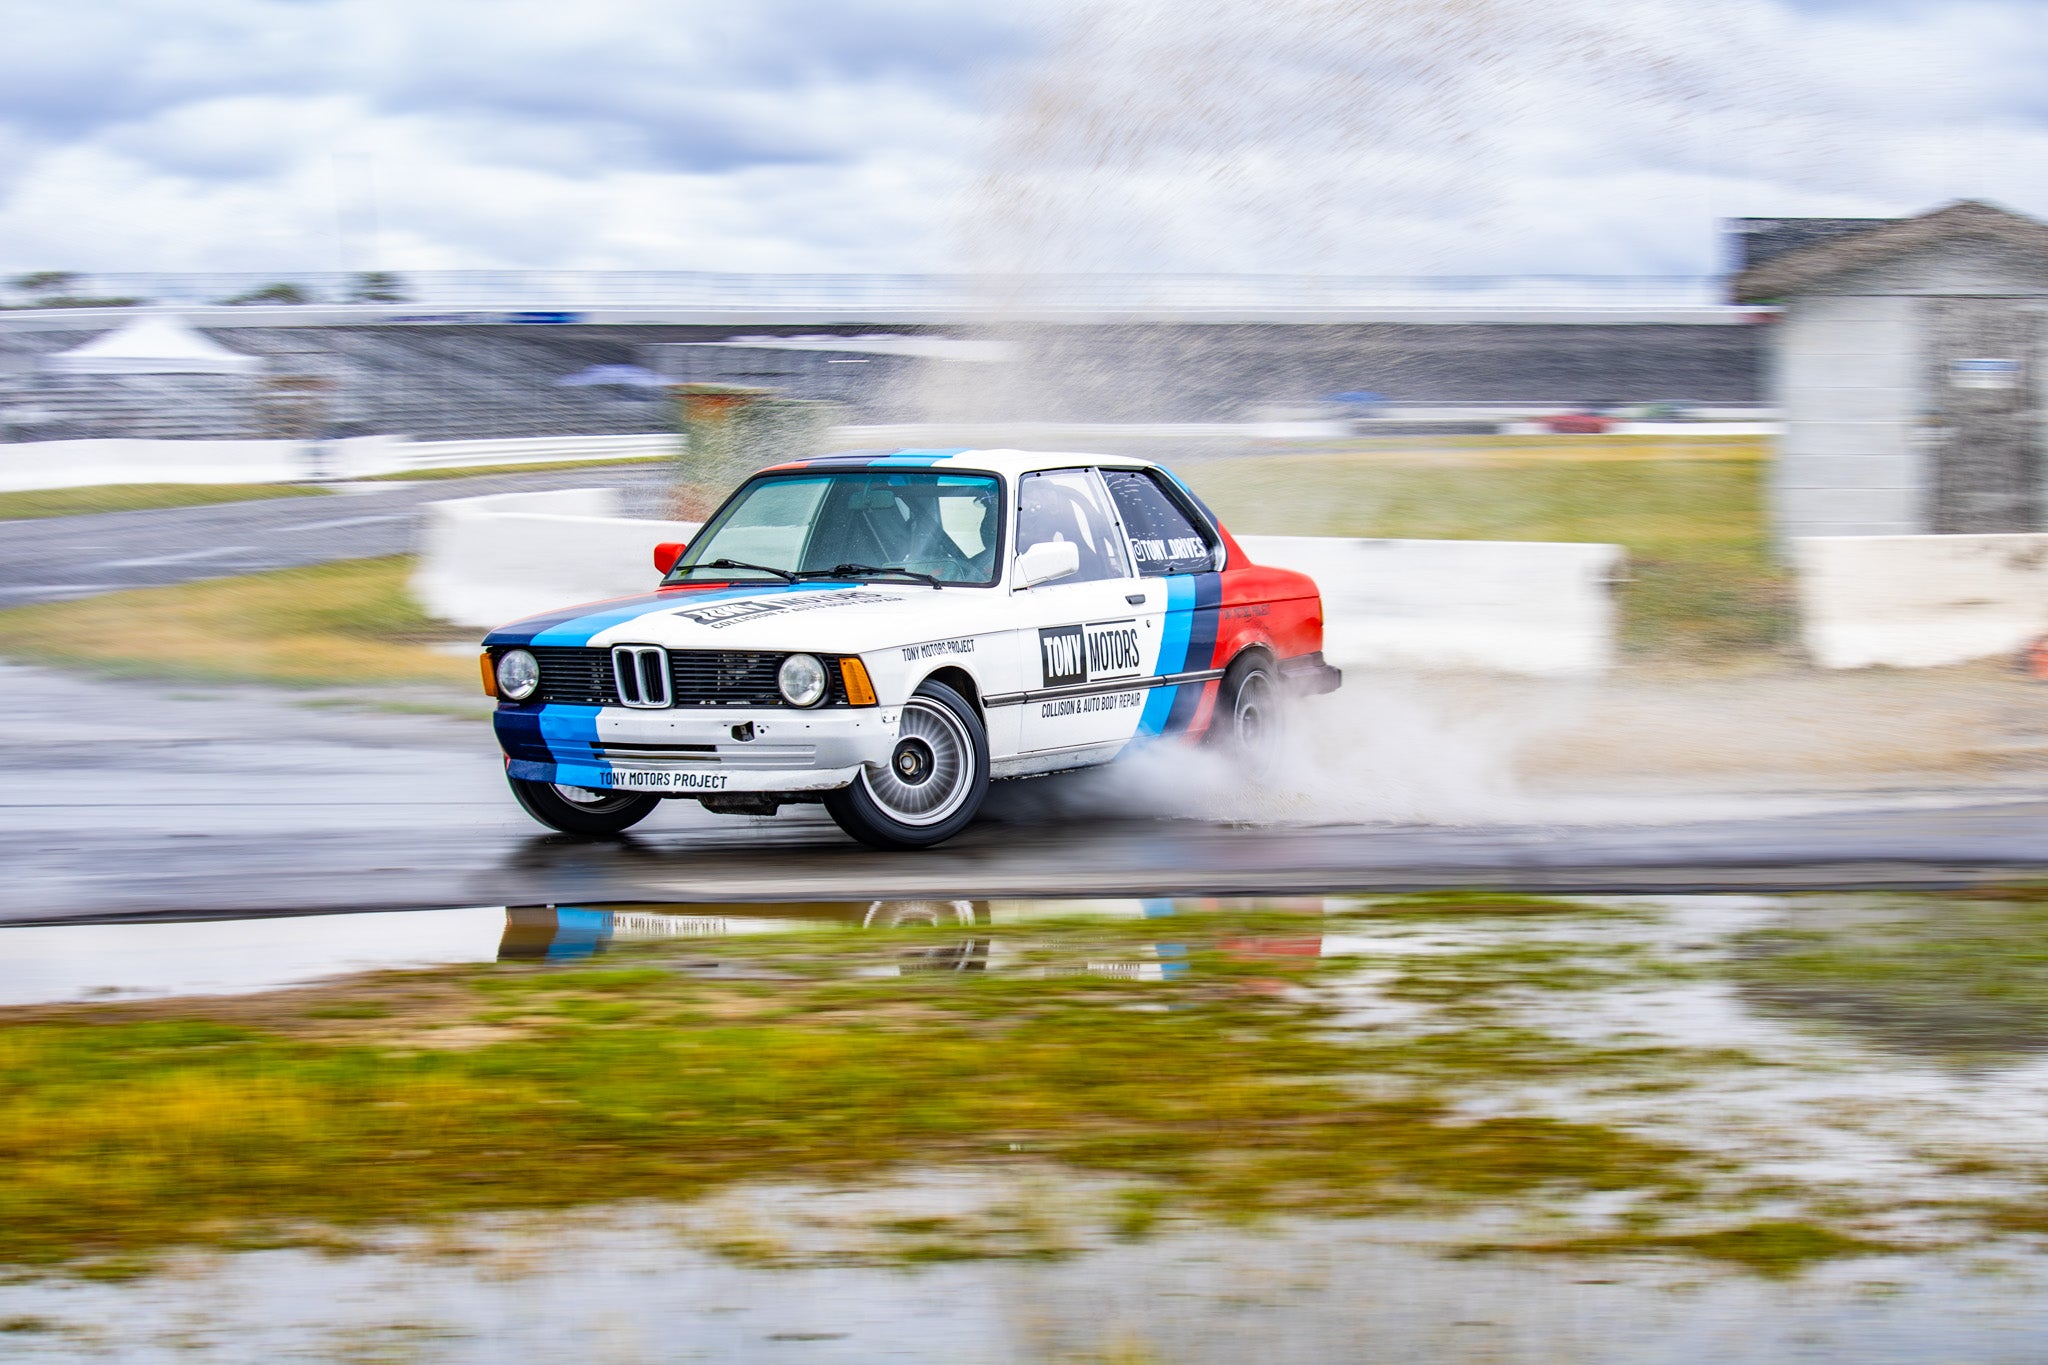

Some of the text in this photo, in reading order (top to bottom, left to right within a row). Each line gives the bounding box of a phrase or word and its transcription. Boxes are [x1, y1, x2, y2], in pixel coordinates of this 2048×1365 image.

[902, 639, 975, 661] TONY MOTORS PROJECT
[1043, 628, 1140, 678] TONY MOTORS
[1042, 692, 1141, 718] COLLISION & AUTO BODY REPAIR
[600, 772, 727, 789] TONY MOTORS PROJECT
